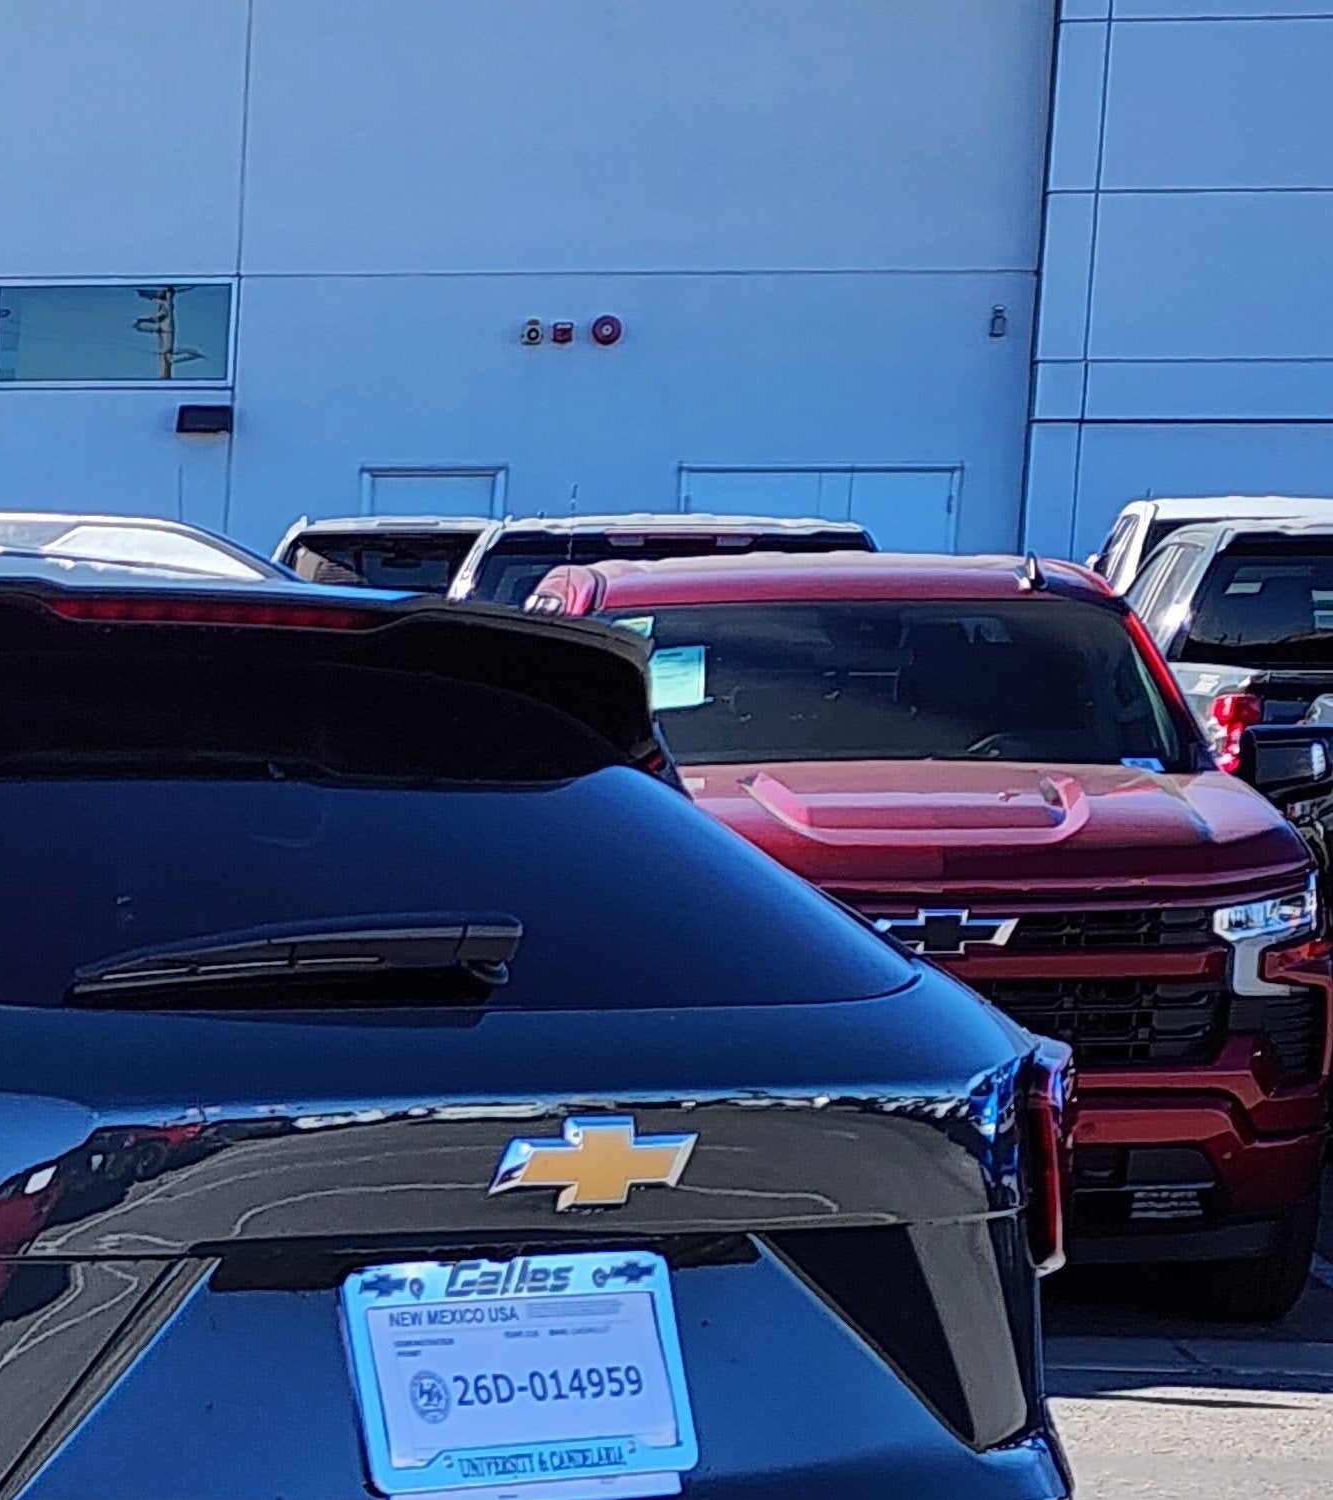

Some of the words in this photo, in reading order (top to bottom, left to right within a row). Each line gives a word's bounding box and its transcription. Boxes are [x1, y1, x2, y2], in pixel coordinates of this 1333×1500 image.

[444, 1260, 574, 1298] Galles
[388, 1311, 423, 1328] NEW
[427, 1307, 485, 1326] MEXICO
[488, 1305, 520, 1323] USA
[452, 1364, 644, 1407] 26D-014959
